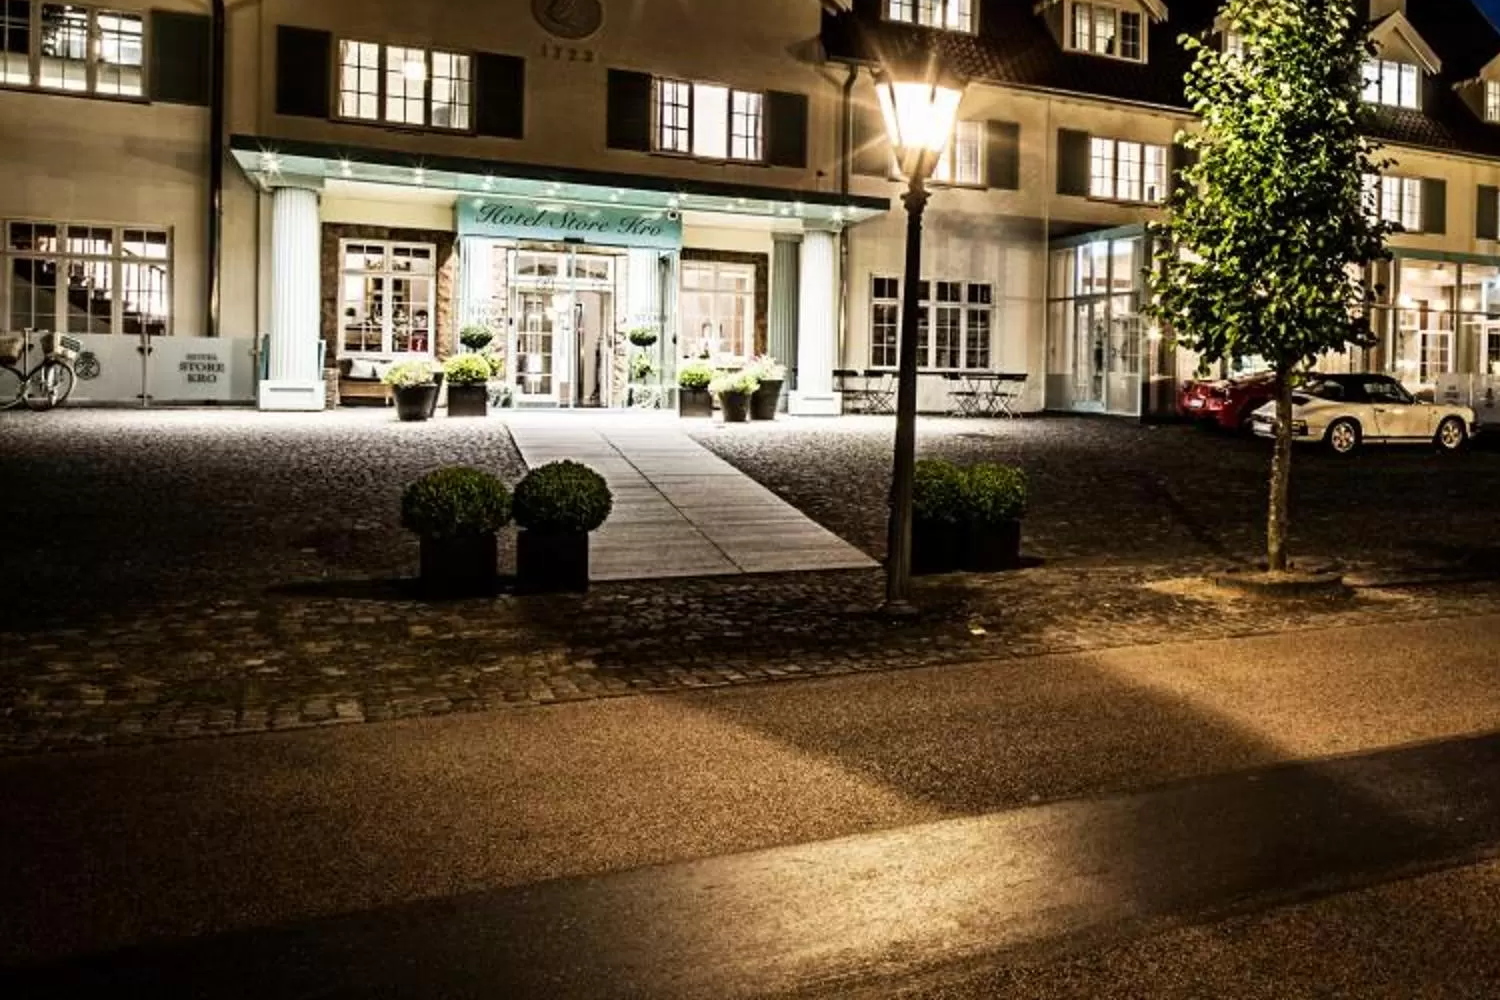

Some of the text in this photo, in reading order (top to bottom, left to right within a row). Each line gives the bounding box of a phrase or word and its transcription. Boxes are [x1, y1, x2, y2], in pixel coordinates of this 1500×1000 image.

[476, 203, 662, 237] Hotel Store Kro
[179, 361, 225, 373] STORE
[187, 373, 217, 383] KRO
